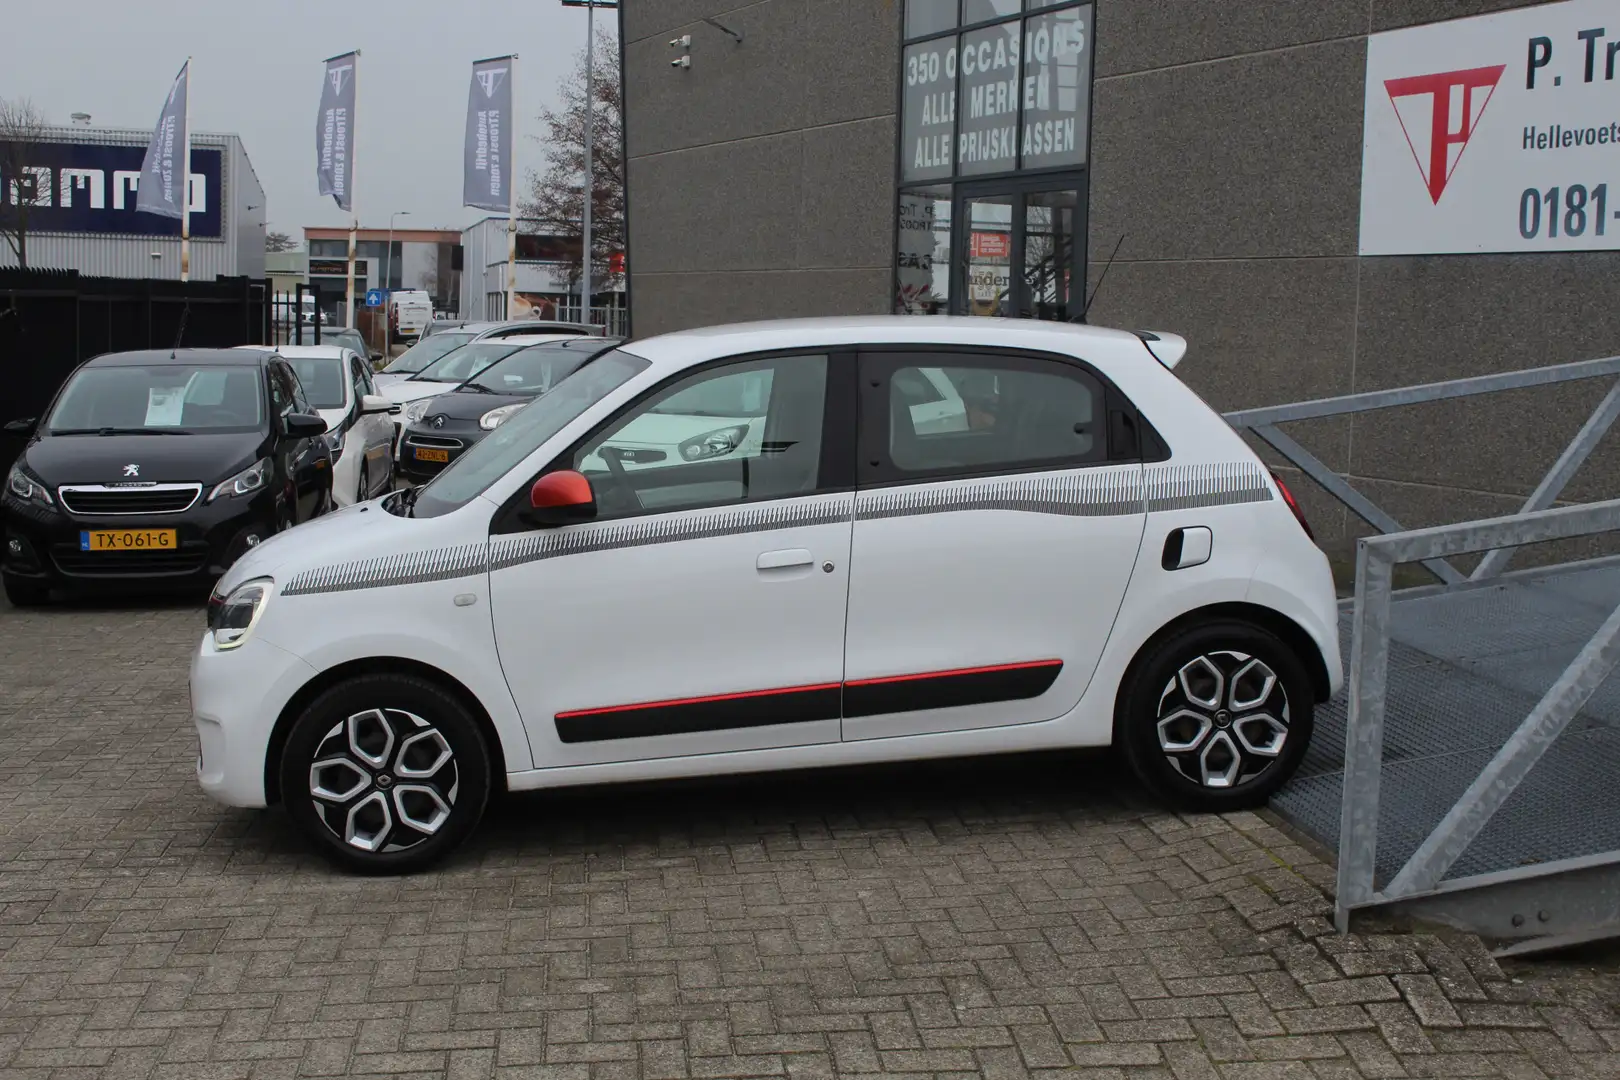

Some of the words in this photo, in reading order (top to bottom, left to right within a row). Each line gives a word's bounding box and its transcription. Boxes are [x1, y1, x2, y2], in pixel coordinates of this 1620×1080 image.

[908, 52, 939, 86] 350
[945, 20, 1084, 79] OCCASIONS
[1526, 36, 1561, 89] P.
[922, 91, 957, 126] ALLE
[971, 74, 1050, 120] MERKEN
[914, 134, 949, 168] ALLE
[96, 532, 169, 548] TX-061-G
